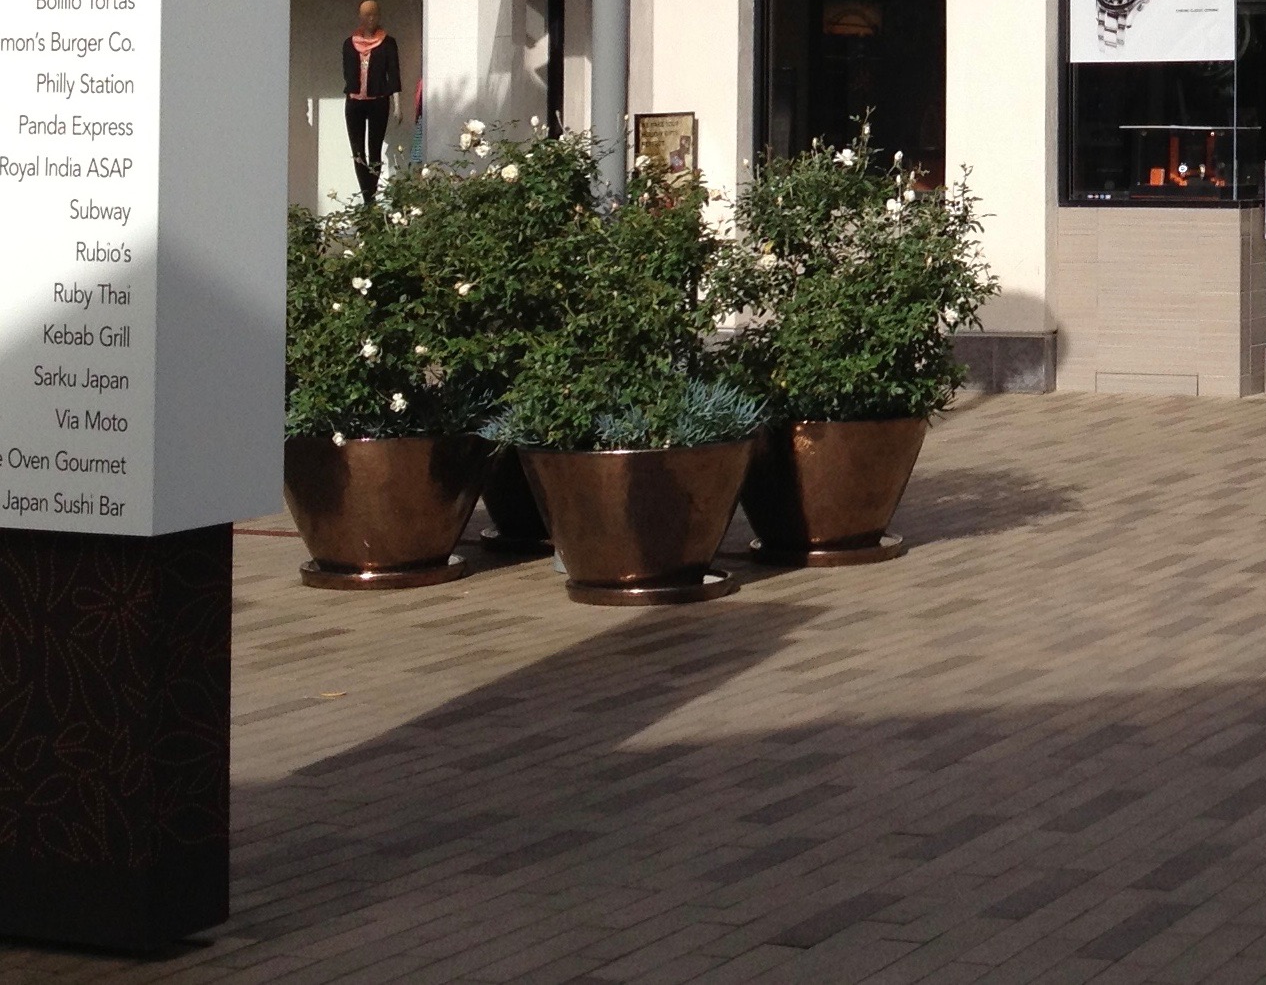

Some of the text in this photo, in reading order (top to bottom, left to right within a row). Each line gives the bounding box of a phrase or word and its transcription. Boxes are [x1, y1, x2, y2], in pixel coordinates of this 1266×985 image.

[51, 31, 103, 58] Burger
[108, 31, 136, 53] Co.
[37, 72, 134, 100] Philly Station
[19, 114, 134, 141] Panda Express
[0, 156, 133, 182] Royal India ASAP
[70, 199, 132, 226] Subway
[76, 241, 132, 263] Rubio's
[54, 282, 131, 310] Ruby Thai
[43, 324, 130, 348] Kebab Grill
[34, 365, 129, 394] Sarku Japan
[55, 409, 128, 432] Via Moto
[7, 448, 50, 470] Oven
[55, 450, 127, 475] Gourmet
[2, 490, 126, 517] Japan Sushi Bar
